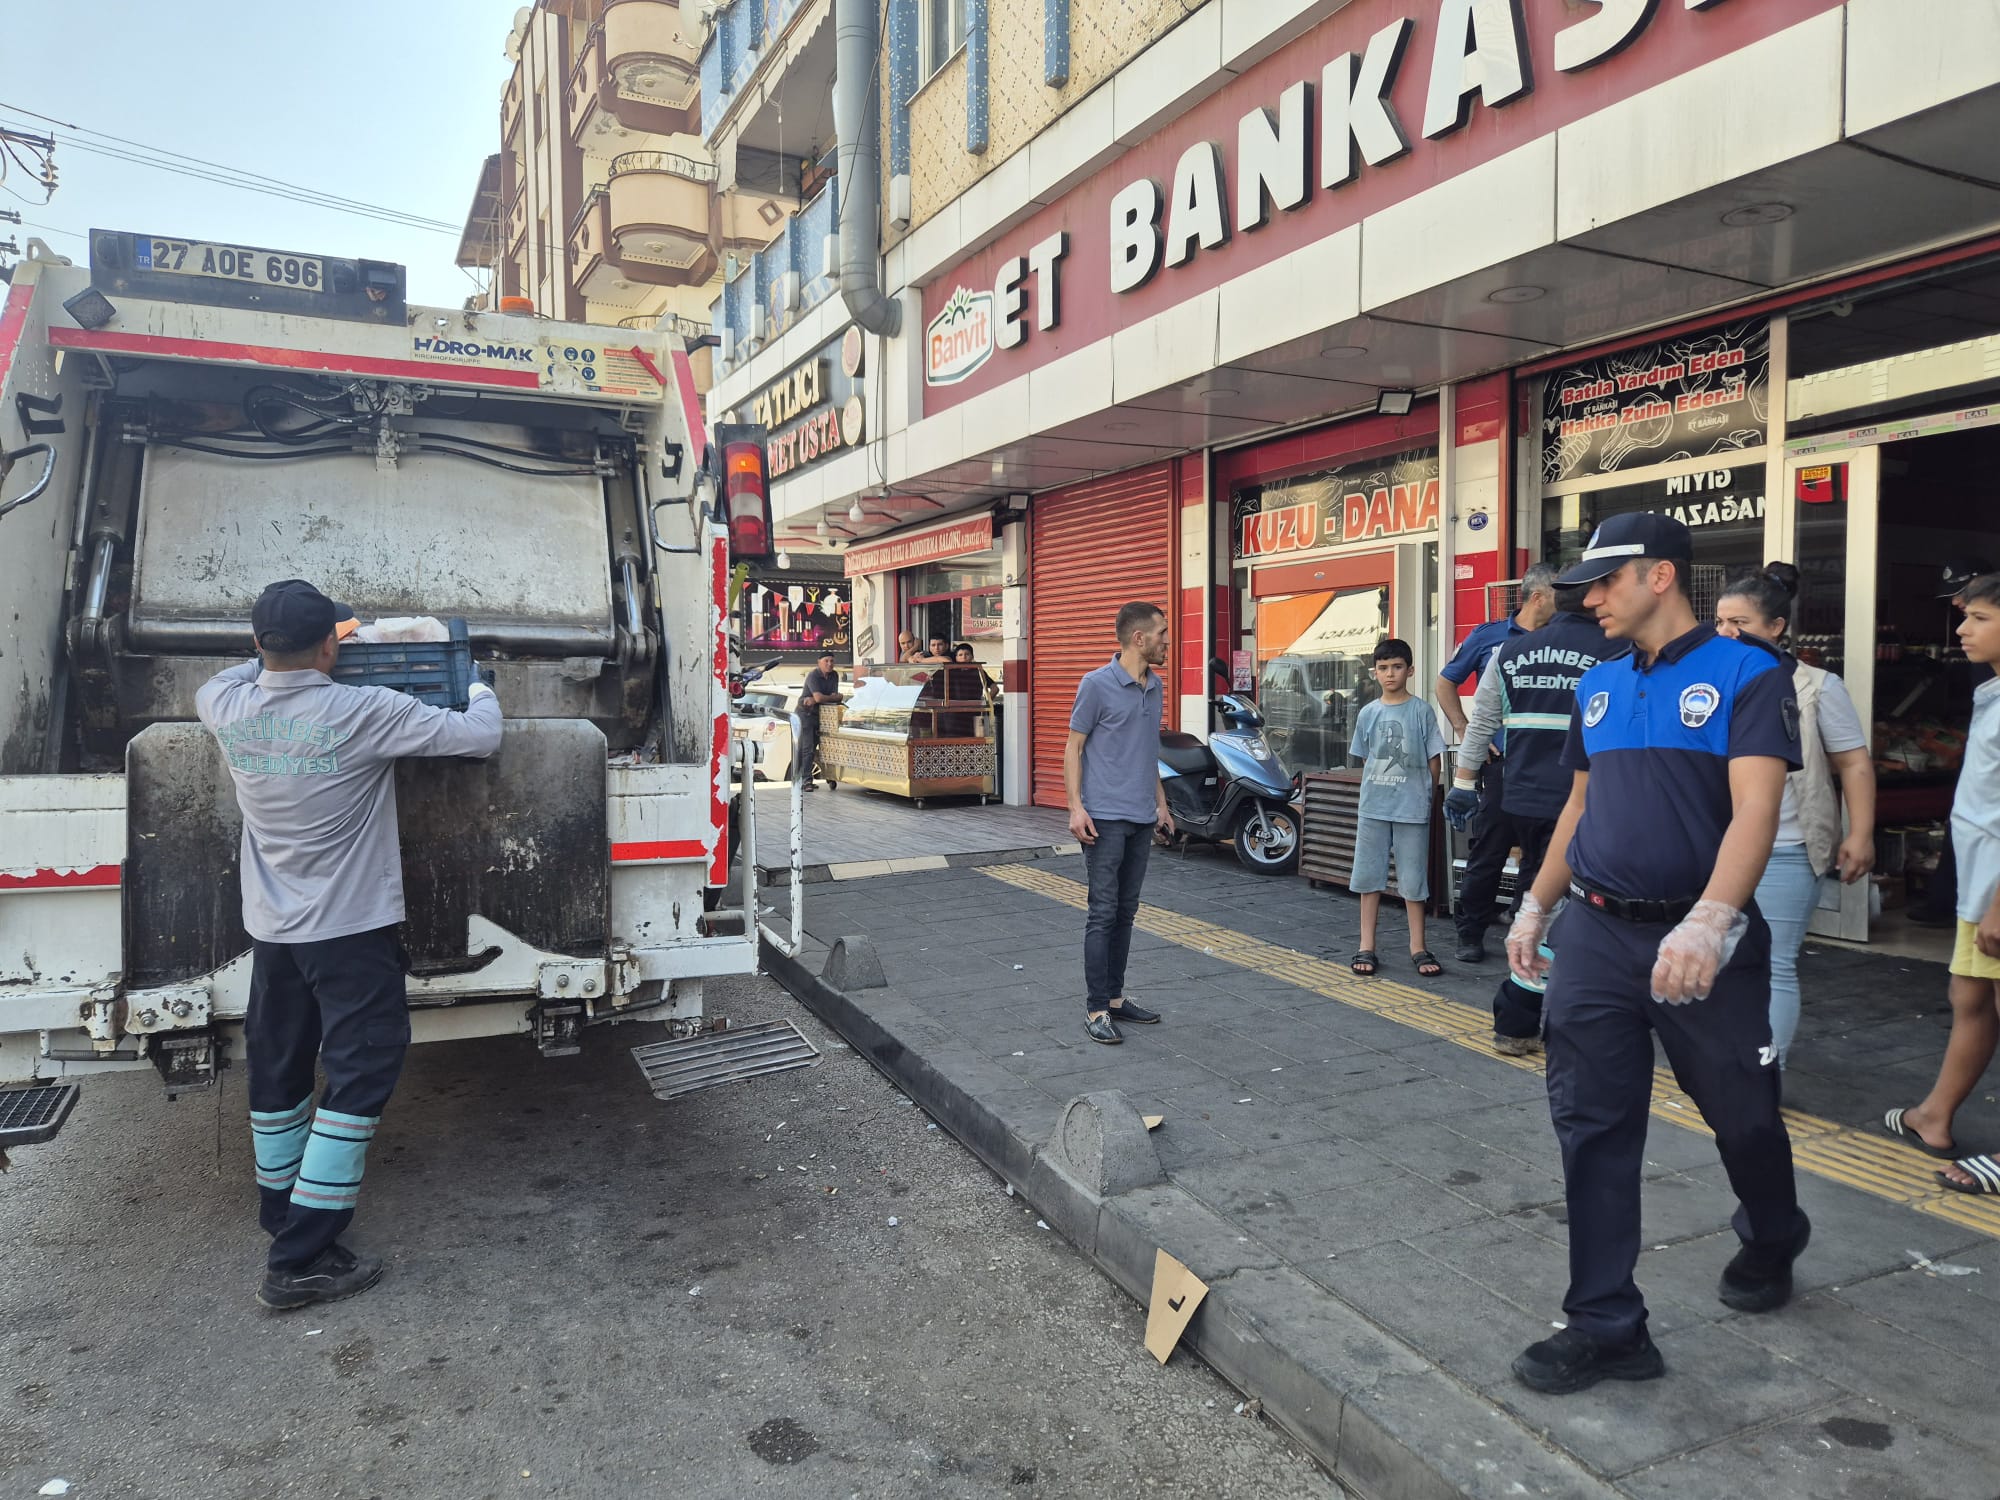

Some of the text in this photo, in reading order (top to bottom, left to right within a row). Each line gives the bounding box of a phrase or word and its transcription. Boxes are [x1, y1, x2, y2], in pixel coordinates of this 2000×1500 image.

[995, 231, 1069, 350] ET
[1111, 0, 1718, 294] BANKA
[138, 255, 151, 265] TR
[153, 242, 188, 270] 27
[266, 256, 318, 287] 696
[931, 312, 987, 370] Banvit
[752, 356, 820, 431] TATLICI
[1562, 348, 1745, 406] Batıla Yardım Eden
[767, 407, 840, 479] MET USTA
[1560, 412, 1617, 438] Hakka
[1621, 400, 1671, 425] Zulm
[1242, 501, 1318, 558] KUZU
[1343, 477, 1440, 542] DANA
[1503, 645, 1602, 676] ŞAHİNBE
[1512, 673, 1581, 691] BELEDİYE
